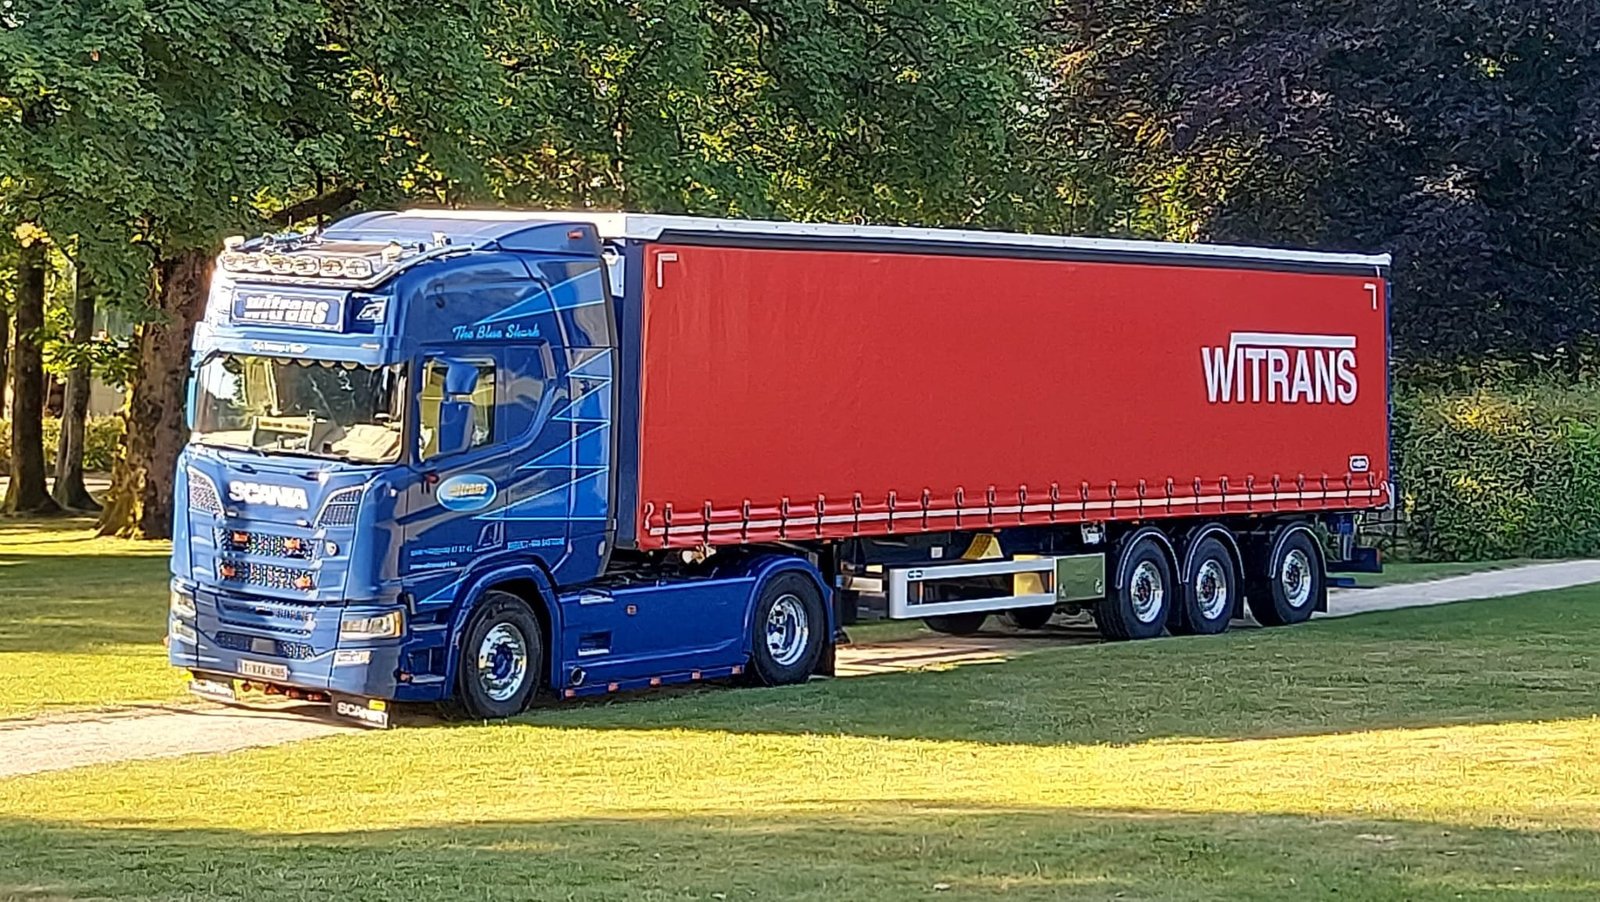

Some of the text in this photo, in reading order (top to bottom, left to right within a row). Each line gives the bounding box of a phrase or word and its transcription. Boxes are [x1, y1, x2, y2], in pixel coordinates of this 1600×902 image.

[452, 323, 540, 340] The Blue Shark
[1201, 332, 1358, 404] WITRANS
[228, 481, 309, 510] SCANIA
[337, 702, 384, 723] SCANIA
